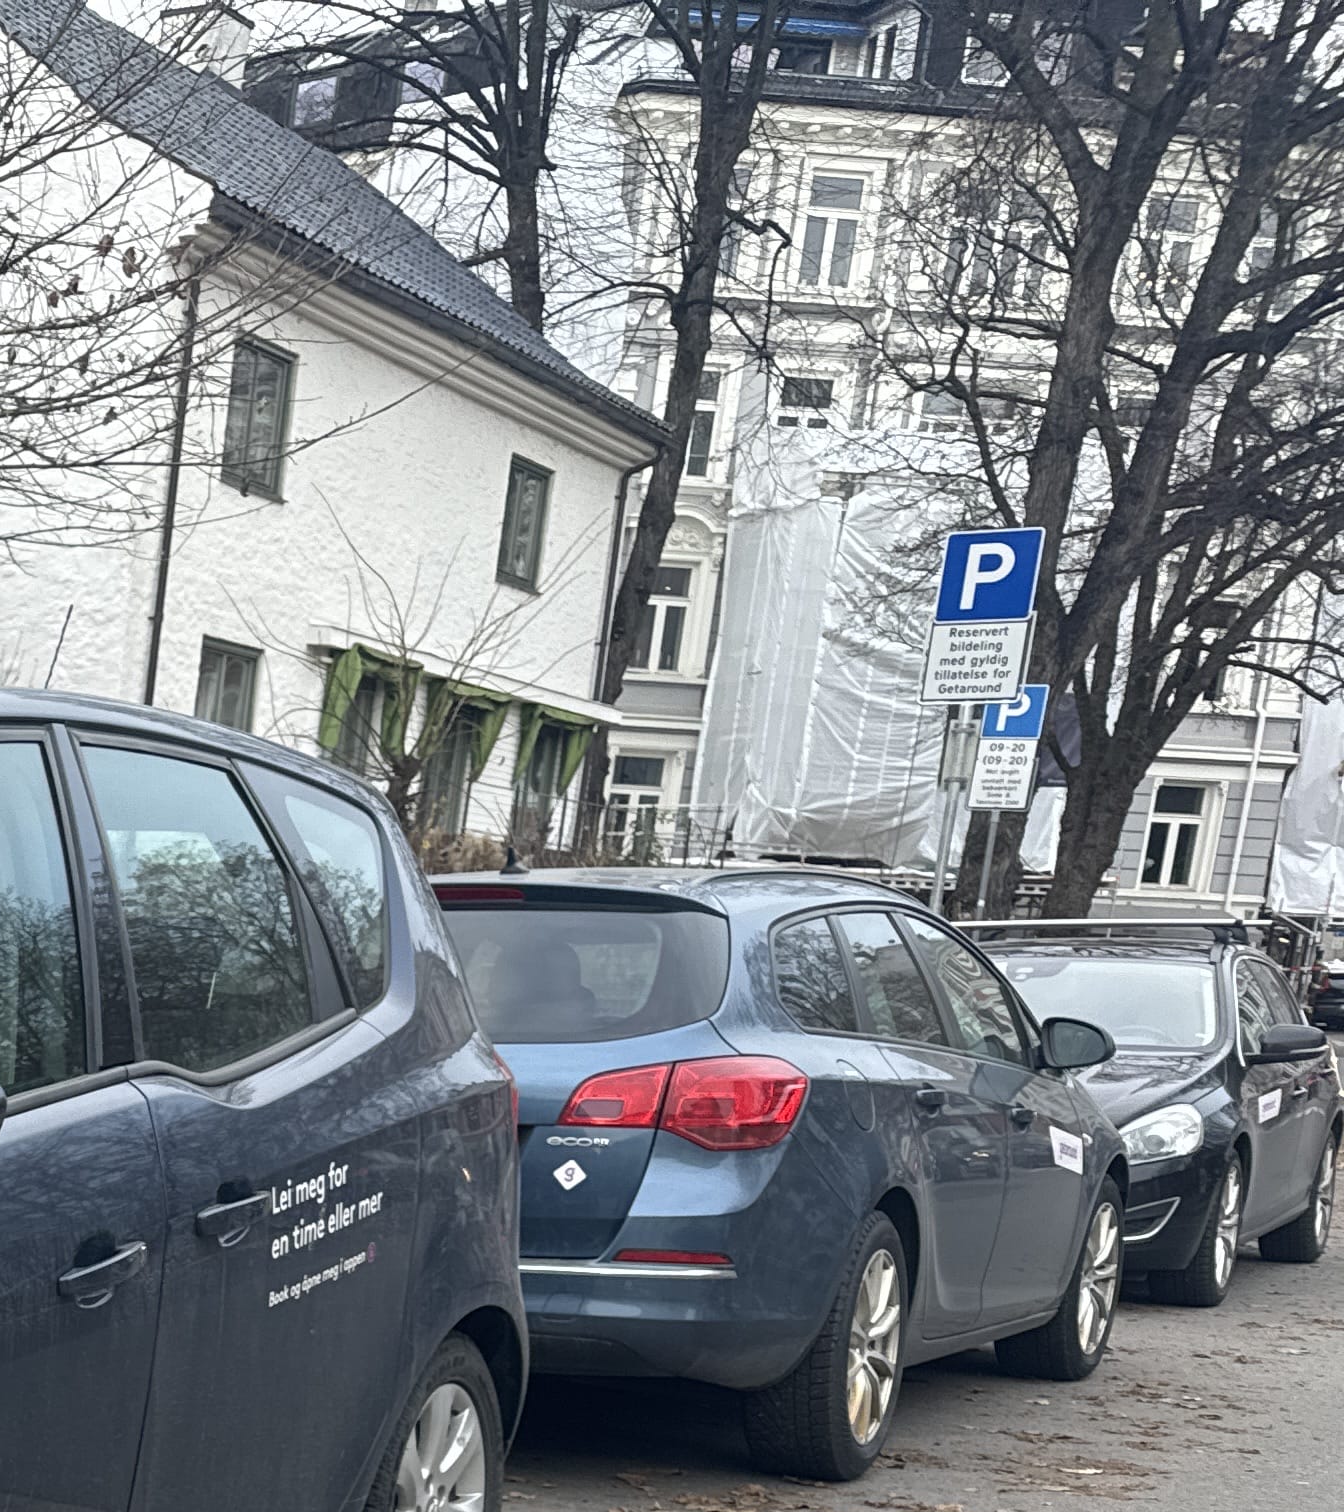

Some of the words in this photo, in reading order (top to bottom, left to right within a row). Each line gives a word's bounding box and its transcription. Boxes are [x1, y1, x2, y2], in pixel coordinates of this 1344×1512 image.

[959, 542, 1016, 610] P
[949, 626, 1009, 638] Reservert
[949, 641, 1003, 653] bildeling
[934, 669, 988, 680] tillatelse
[993, 668, 1012, 679] for
[939, 655, 966, 666] med
[970, 655, 1009, 668] gyldig
[938, 683, 1002, 694] Getaround
[995, 692, 1031, 731] P
[272, 1179, 293, 1215] Lei
[295, 1174, 325, 1204] meg
[328, 1161, 349, 1190] for
[271, 1234, 289, 1259] en
[292, 1218, 325, 1249] time
[328, 1202, 356, 1234] eller
[358, 1191, 384, 1220] mer
[268, 1285, 289, 1308] Book
[290, 1282, 301, 1299] og
[322, 1265, 339, 1281] meg
[340, 1257, 344, 1273] i
[344, 1251, 366, 1274] appen
